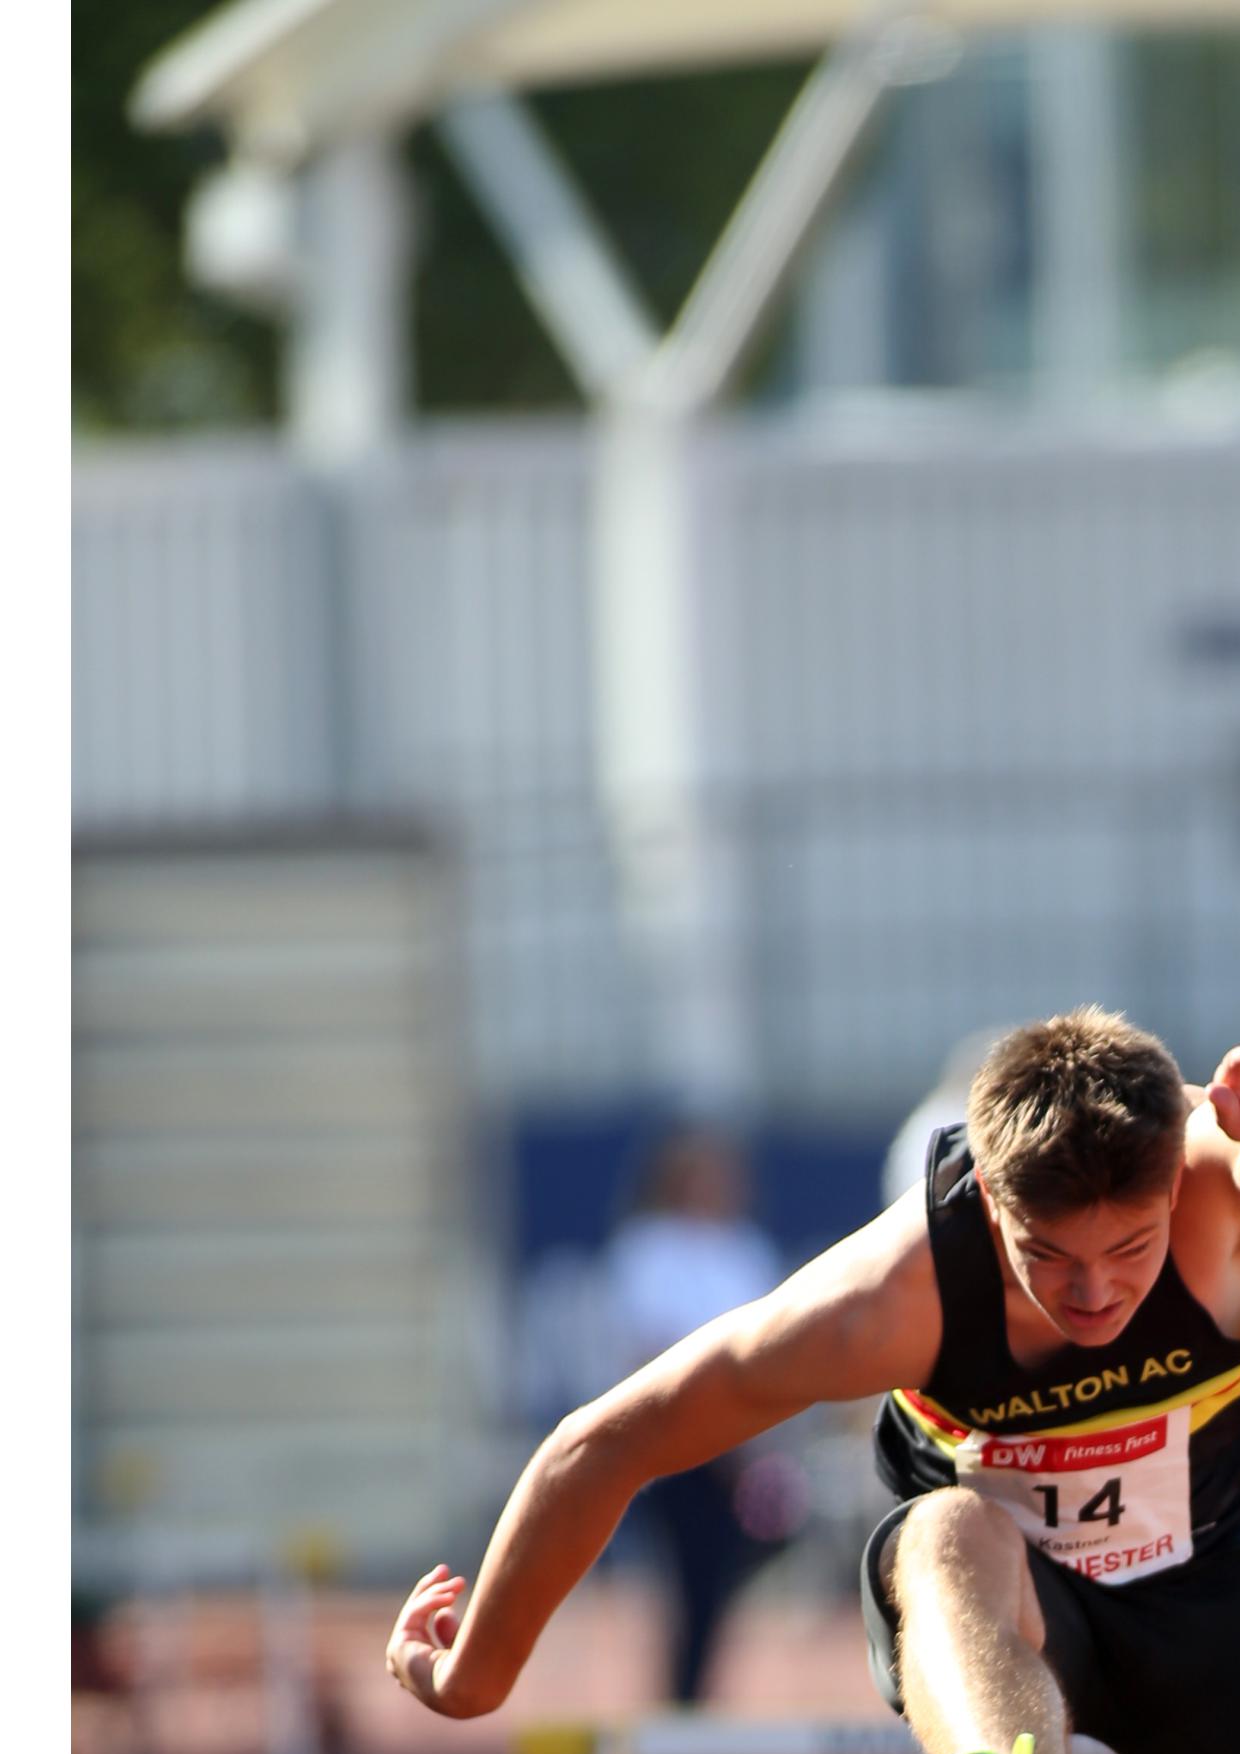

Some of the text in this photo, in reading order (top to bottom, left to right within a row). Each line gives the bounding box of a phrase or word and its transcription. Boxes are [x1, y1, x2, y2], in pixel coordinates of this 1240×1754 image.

[970, 1349, 1194, 1424] WALTON AC
[992, 1445, 1046, 1466] DW
[1064, 1443, 1121, 1462] fitness
[1032, 1477, 1125, 1528] 14
[1038, 1535, 1111, 1551] Kastner
